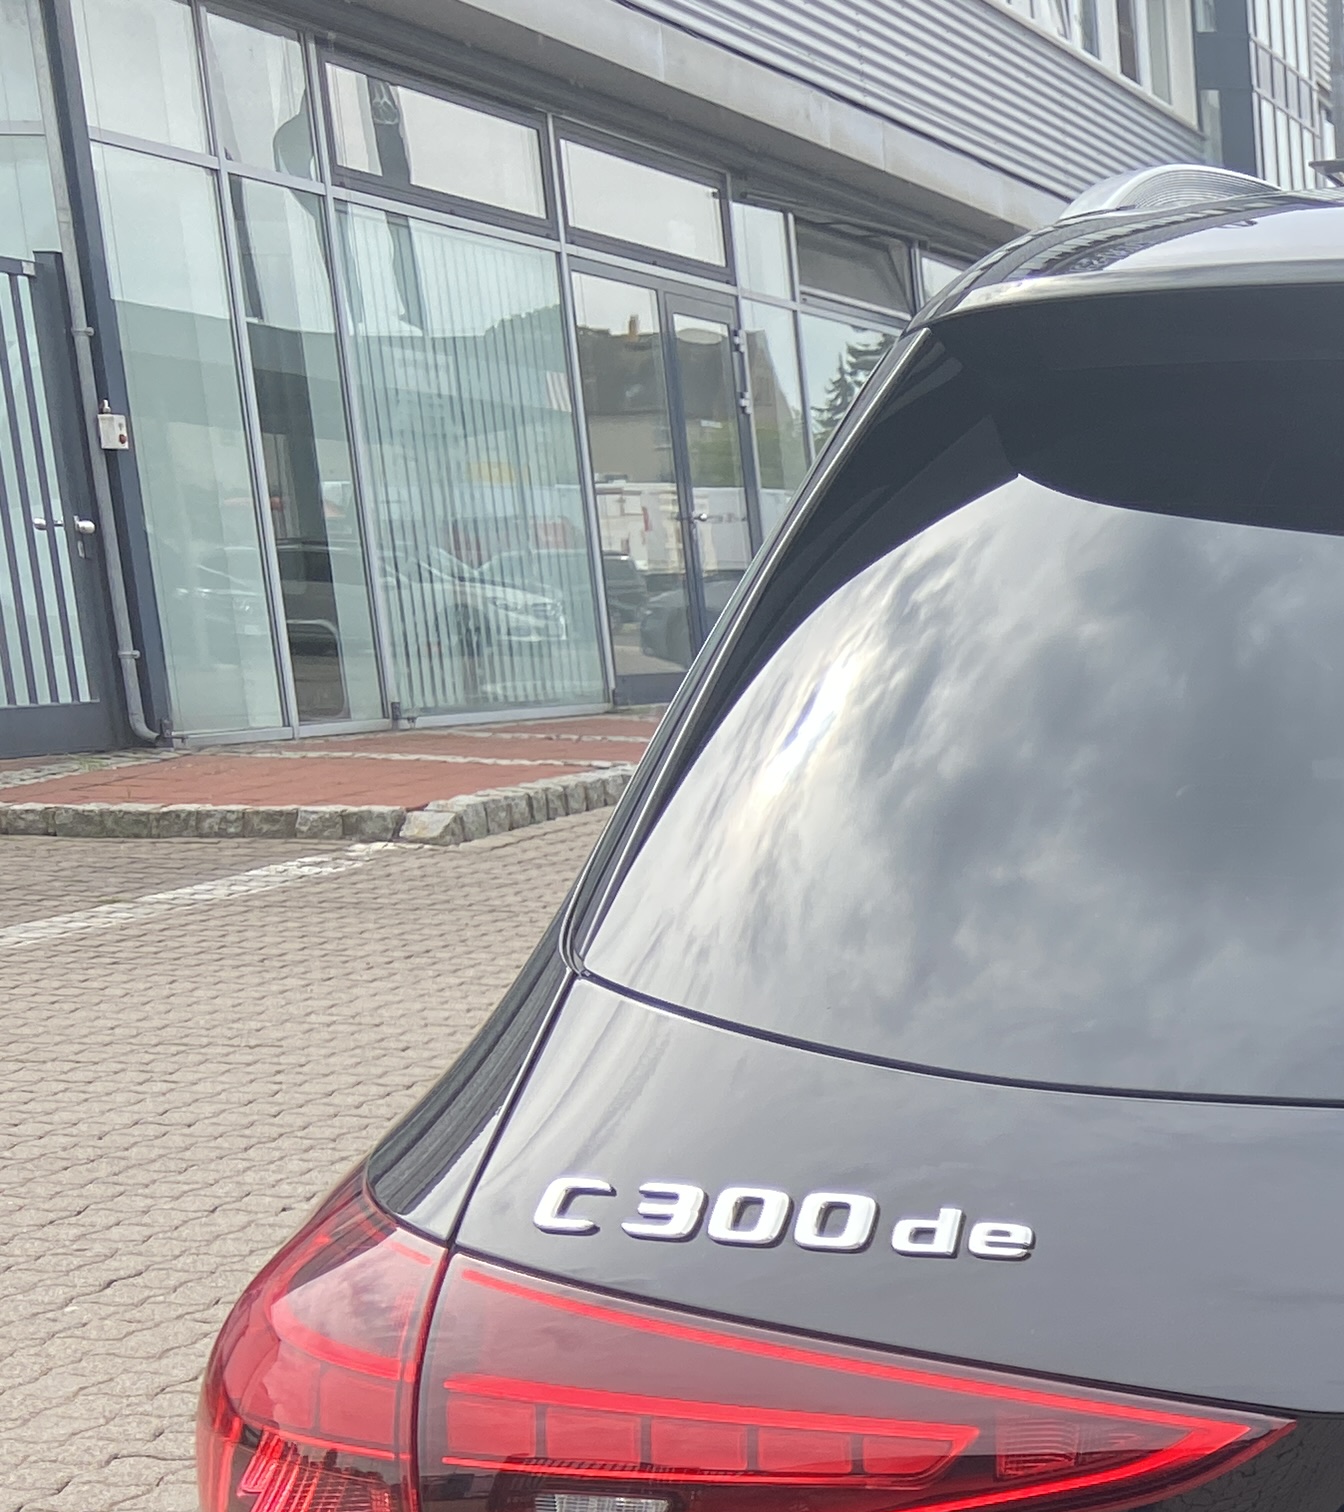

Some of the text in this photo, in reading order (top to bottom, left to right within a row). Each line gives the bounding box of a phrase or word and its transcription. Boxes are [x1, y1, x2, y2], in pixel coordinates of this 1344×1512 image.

[533, 1176, 1036, 1261] C 300 de
